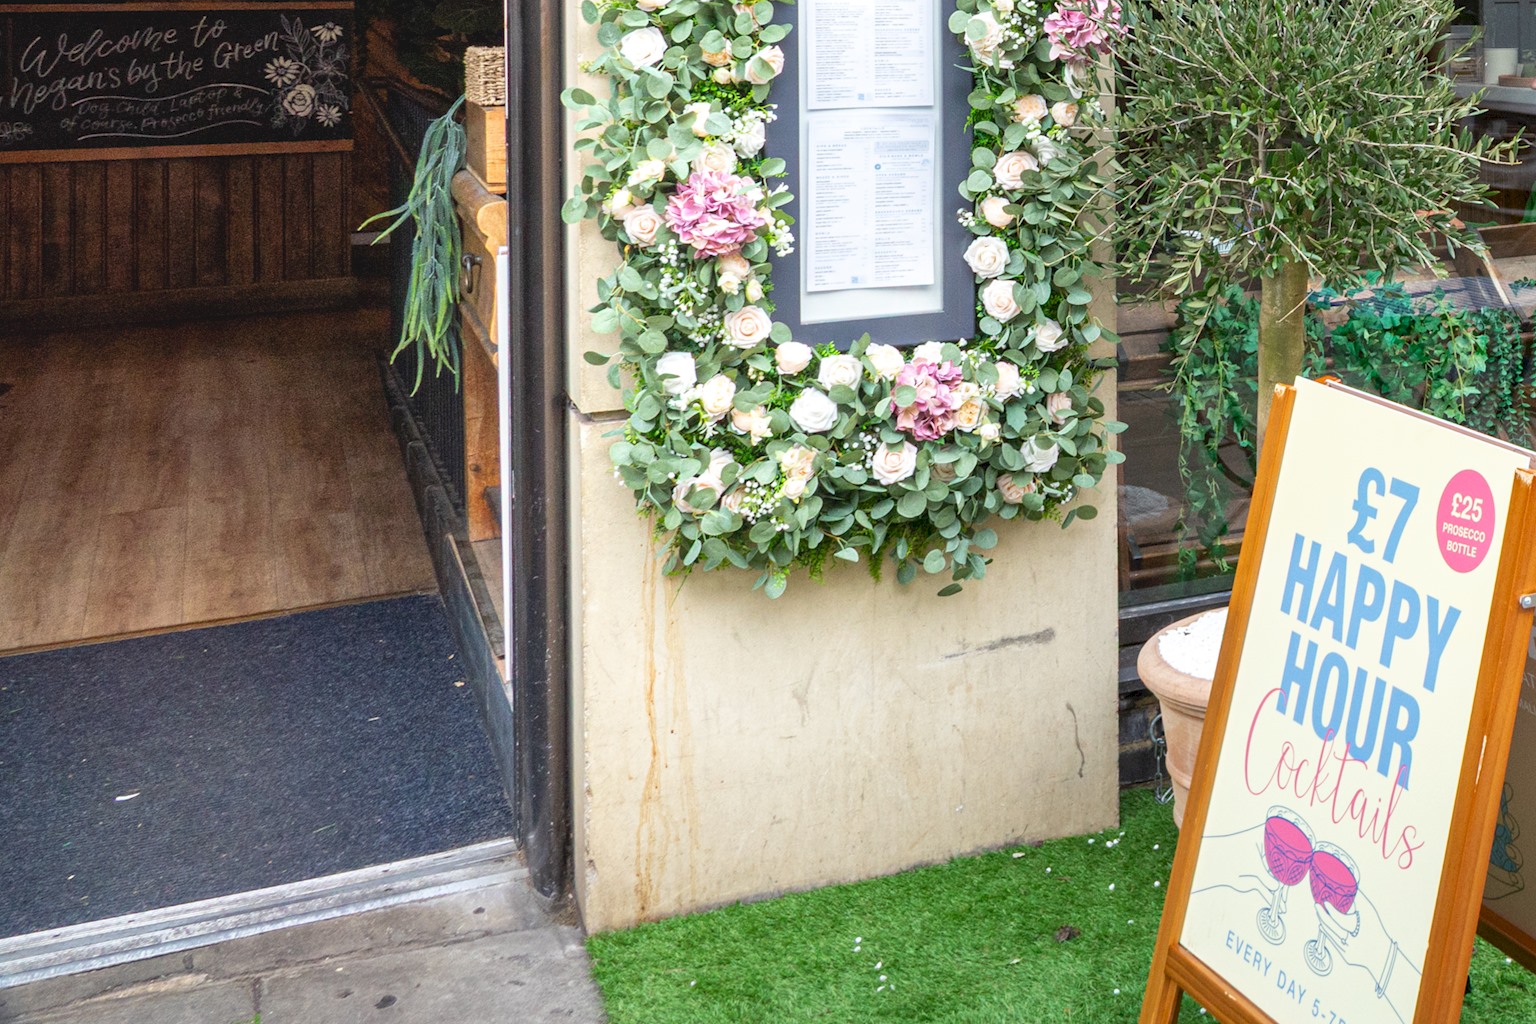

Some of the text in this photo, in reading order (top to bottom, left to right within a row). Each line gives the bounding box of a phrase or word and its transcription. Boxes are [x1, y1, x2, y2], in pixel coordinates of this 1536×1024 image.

[20, 15, 228, 78] Welcome to
[127, 58, 162, 93] by
[161, 50, 204, 81] the
[213, 30, 281, 69] Green
[140, 108, 205, 131] Prosecco
[1347, 466, 1420, 563] £7
[1442, 522, 1485, 543] PROSECCO
[1450, 493, 1483, 523] £25
[1446, 540, 1477, 559] BOTTLE
[1280, 533, 1462, 694] HAPPY
[1277, 630, 1420, 791] HOUR
[1244, 688, 1425, 870] Cocktails
[1225, 930, 1272, 977] EVERY
[1277, 970, 1307, 1005] DAY
